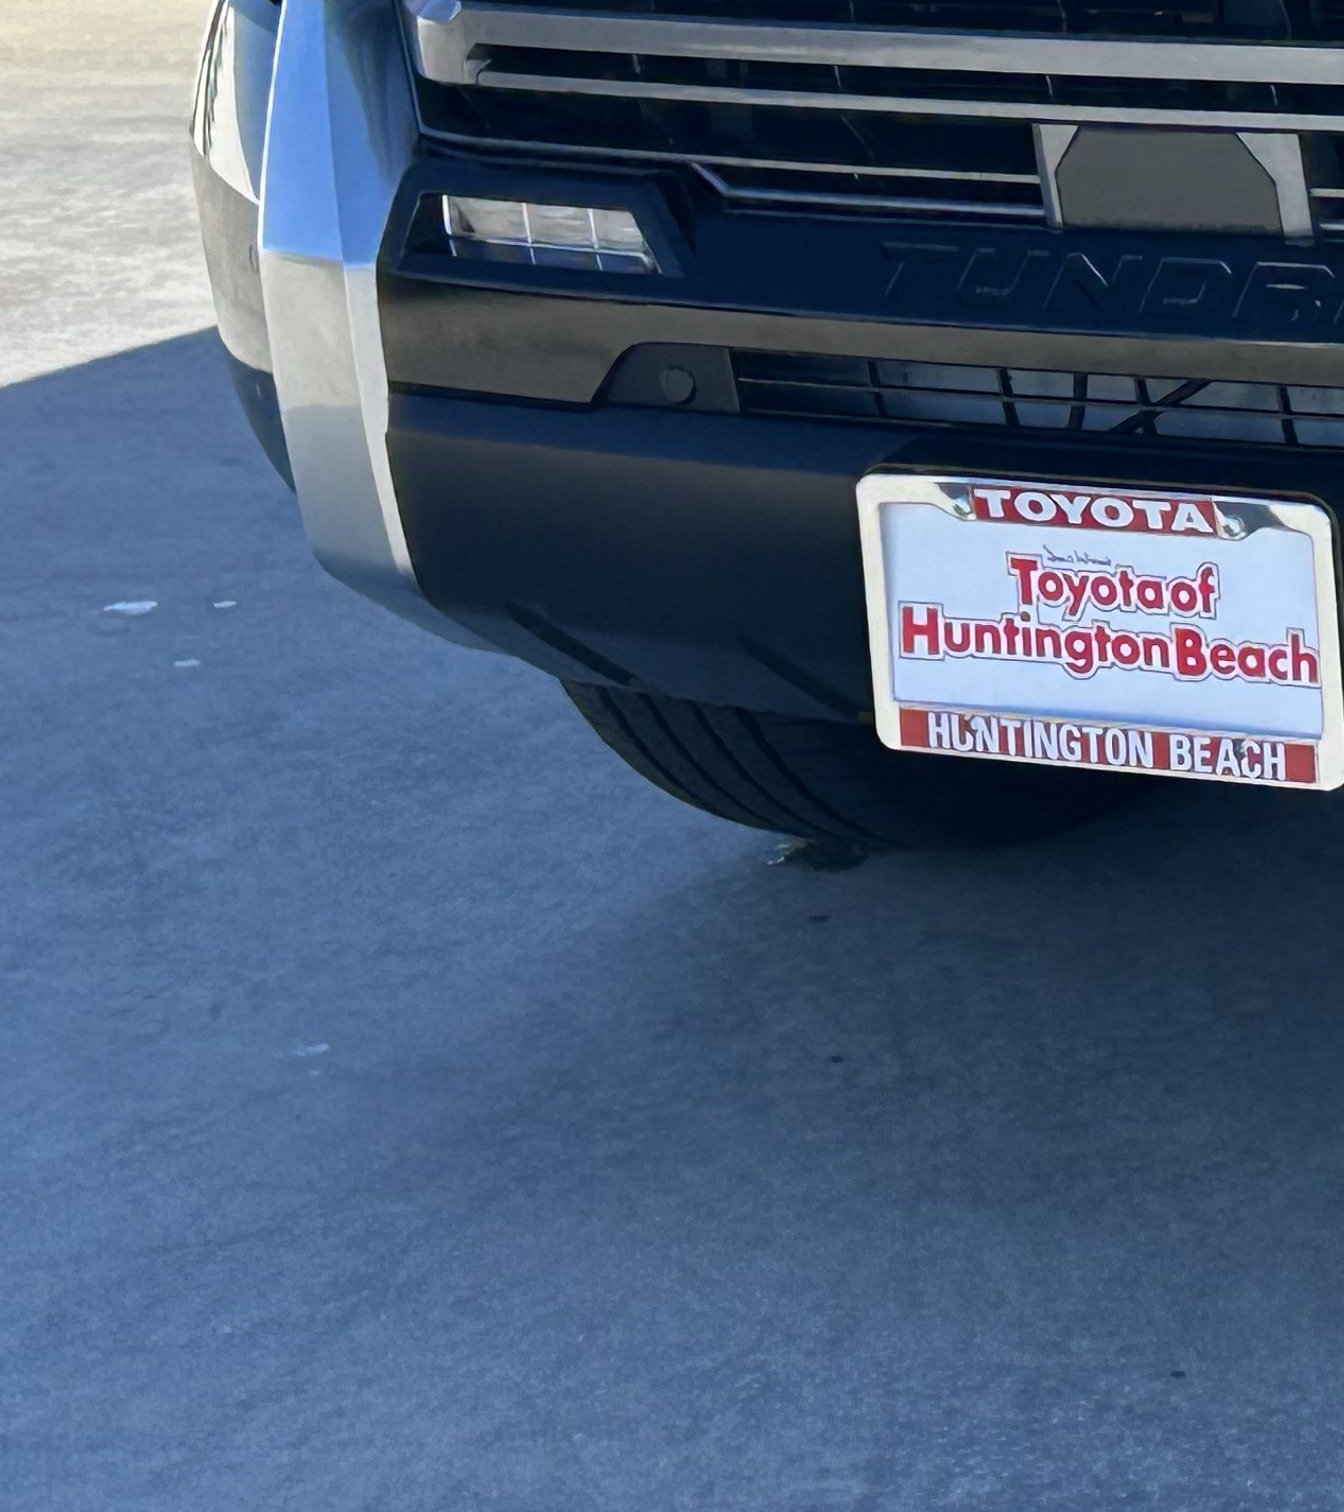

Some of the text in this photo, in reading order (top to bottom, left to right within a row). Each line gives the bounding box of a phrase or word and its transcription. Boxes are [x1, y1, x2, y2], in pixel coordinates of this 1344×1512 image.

[973, 488, 1214, 535] TOYOTA
[1009, 557, 1216, 618] Toyota of
[901, 605, 1320, 686] Huntington Beach
[927, 712, 1285, 781] HUNTINGTON BEACH
